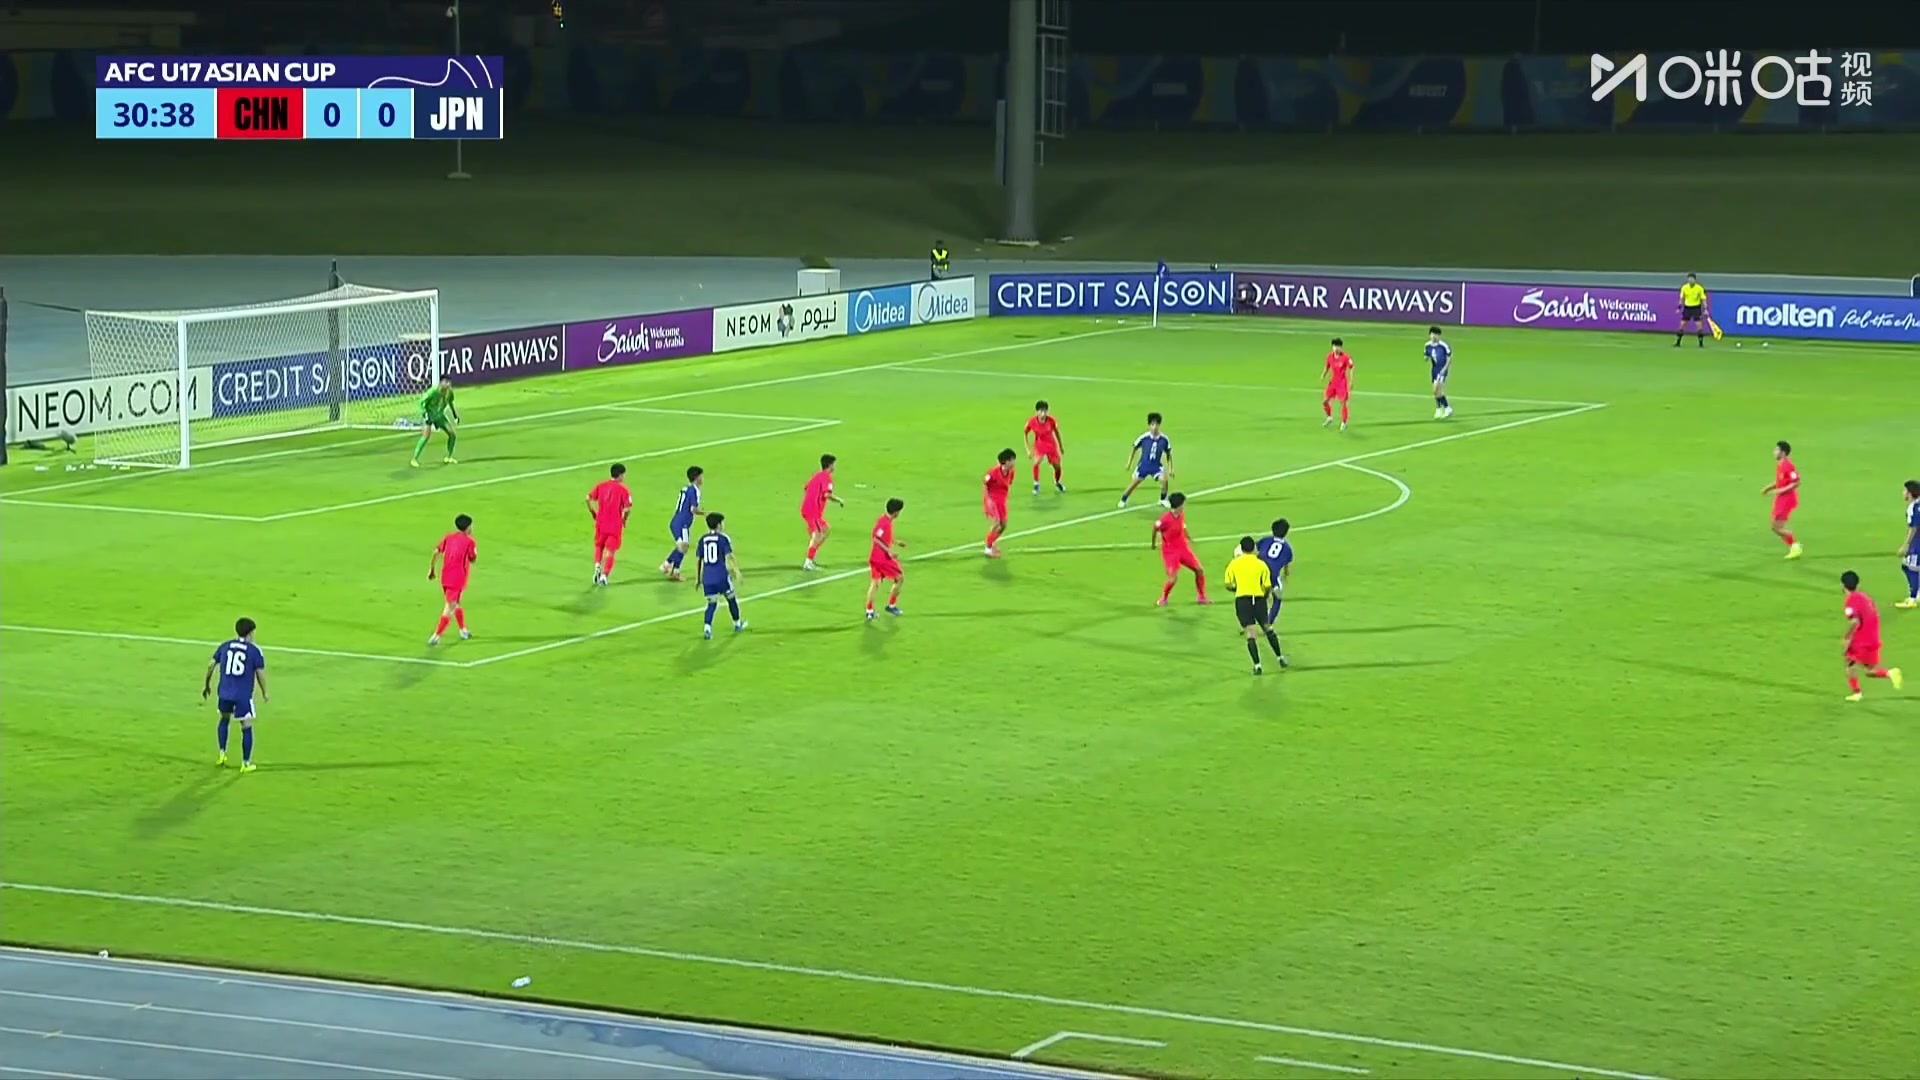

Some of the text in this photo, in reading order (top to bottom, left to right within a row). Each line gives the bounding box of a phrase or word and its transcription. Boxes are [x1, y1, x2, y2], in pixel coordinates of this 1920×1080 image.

[921, 288, 968, 320] Midea
[998, 281, 1104, 308] CREDIT
[1340, 286, 1453, 314] AIRWAYS
[1513, 288, 1649, 323] Saudi Welcome
[726, 311, 771, 338] NEOM
[800, 300, 837, 332] نيوم
[860, 297, 905, 330] Midea
[1607, 310, 1657, 322] to Arabia
[1736, 303, 1834, 328] molten
[481, 335, 558, 371] AIRWAYS
[597, 321, 680, 363] Saudi Welcome
[655, 337, 685, 350] to Arabia
[218, 354, 397, 406] CREDIT SISON
[703, 542, 718, 563] 10
[1268, 542, 1282, 559] 8
[226, 650, 246, 676] 16
